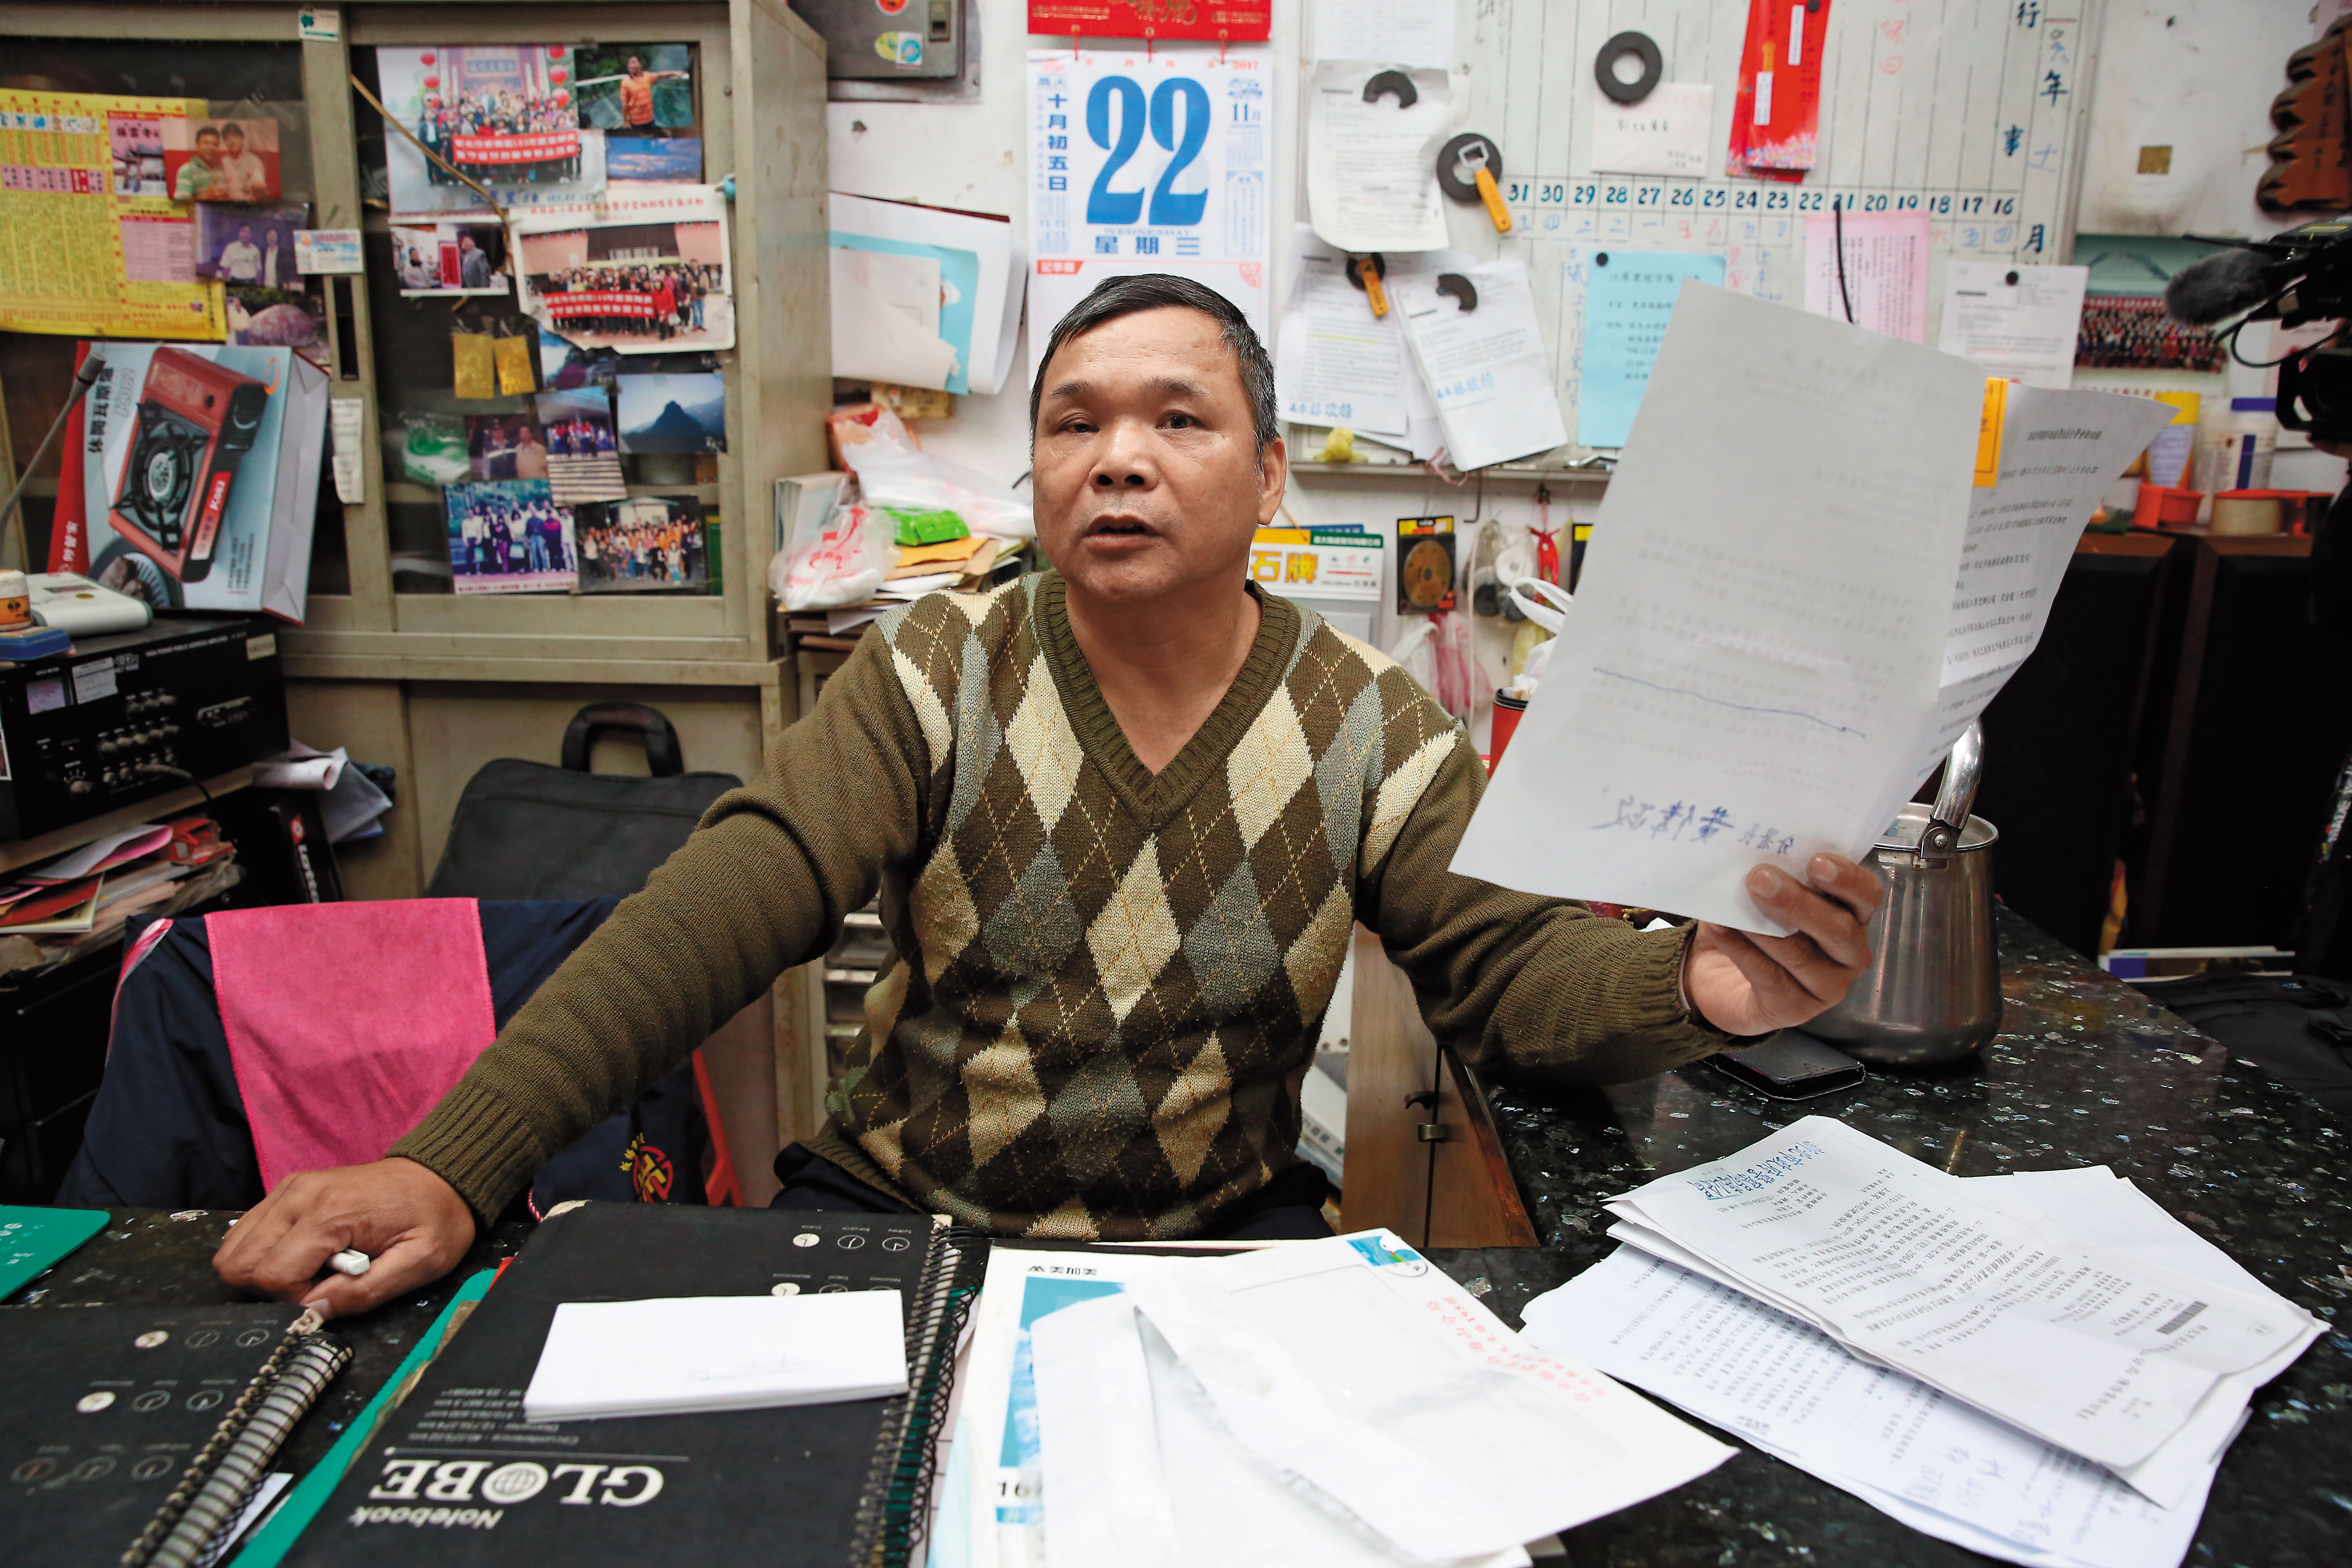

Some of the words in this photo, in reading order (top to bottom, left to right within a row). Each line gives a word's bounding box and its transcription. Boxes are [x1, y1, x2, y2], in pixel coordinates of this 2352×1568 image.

[1232, 60, 1259, 71] 2017
[1047, 94, 1068, 192] 十月初五日
[1086, 75, 1211, 226] 22
[1509, 184, 1529, 202] 31
[1540, 184, 1563, 202] 30
[1575, 185, 1595, 204] 29
[1606, 187, 1627, 203] 28
[1638, 187, 1661, 204] 27
[1672, 188, 1693, 205] 26
[1704, 189, 1725, 207] 25
[1736, 192, 1757, 207] 24
[1767, 192, 1789, 209] 23
[1799, 193, 1822, 211] 22
[1865, 194, 1888, 211] 20
[1898, 195, 1918, 209] 19
[1930, 196, 1951, 213] 18
[1962, 197, 1983, 213] 17
[1994, 198, 2014, 214] 16
[1095, 236, 1200, 256] 星期三
[2022, 223, 2045, 254] 月
[368, 1459, 664, 1507] GLOBE
[349, 1505, 504, 1529] Notebook
